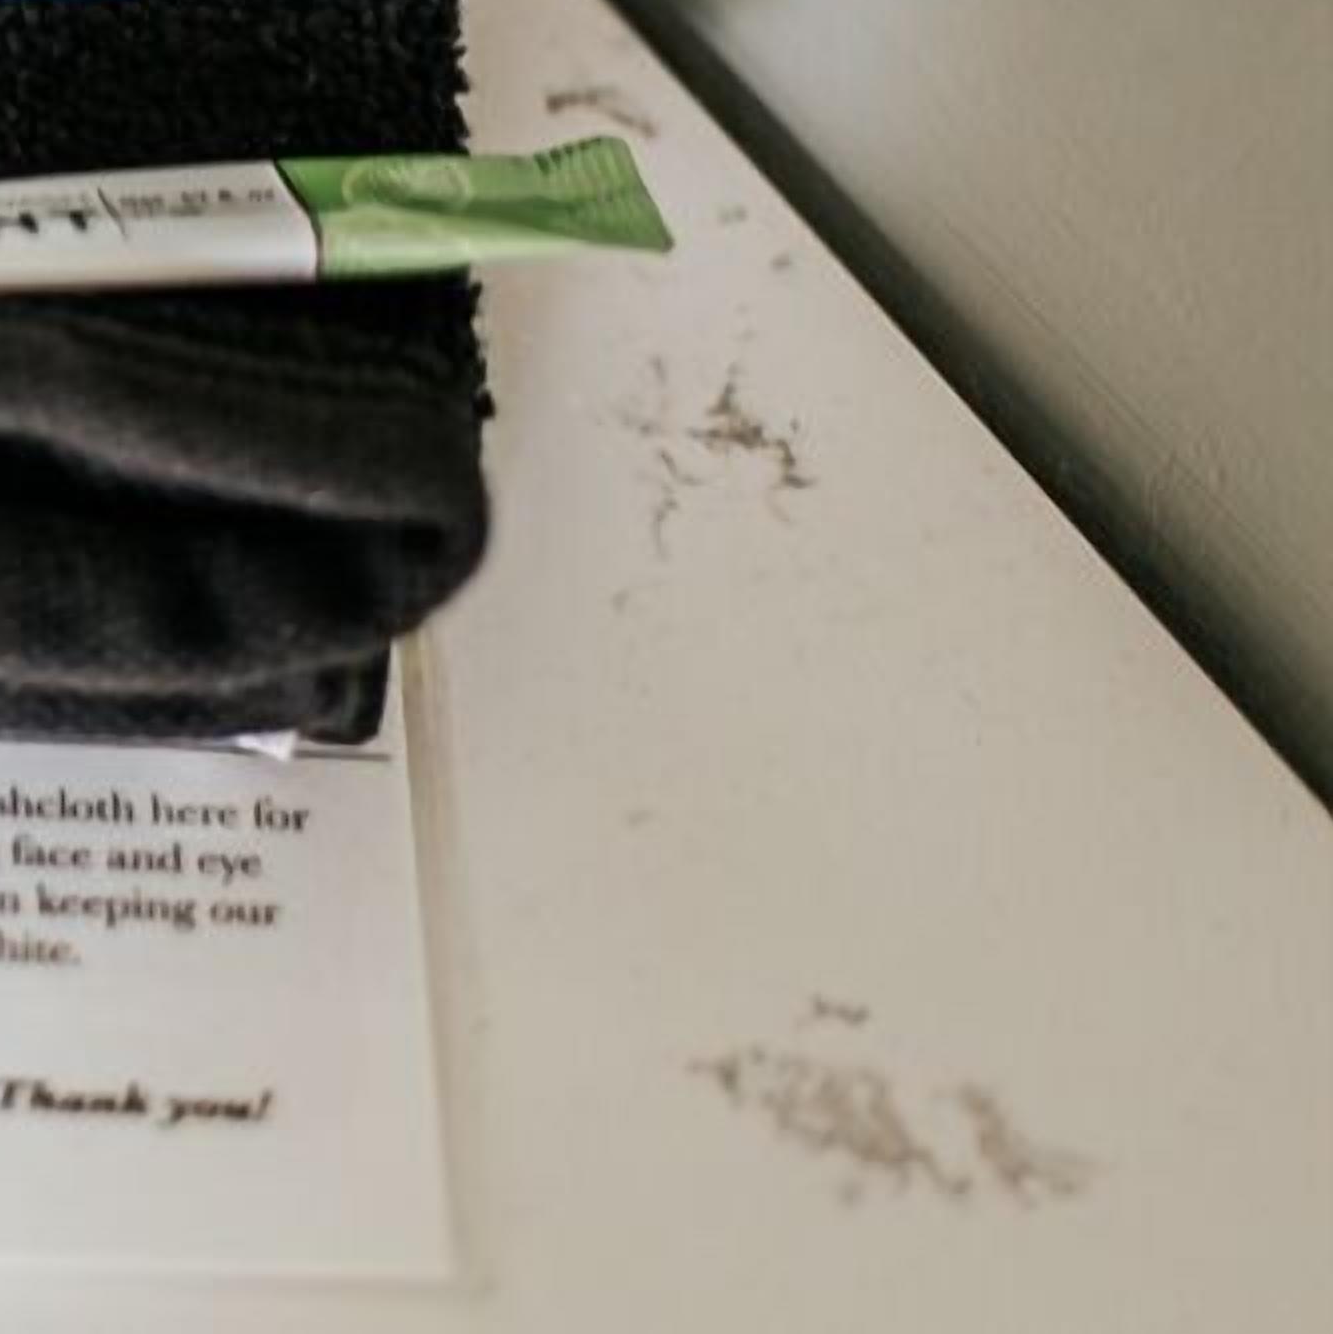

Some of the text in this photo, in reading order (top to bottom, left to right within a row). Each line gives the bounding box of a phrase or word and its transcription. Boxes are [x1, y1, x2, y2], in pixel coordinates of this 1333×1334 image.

[151, 792, 237, 827] here
[253, 795, 311, 832] for
[12, 833, 92, 870] face
[106, 842, 184, 874] and
[197, 852, 263, 886] eye
[36, 882, 197, 929] keeping
[209, 900, 283, 926] our
[155, 1086, 273, 1132] you!
